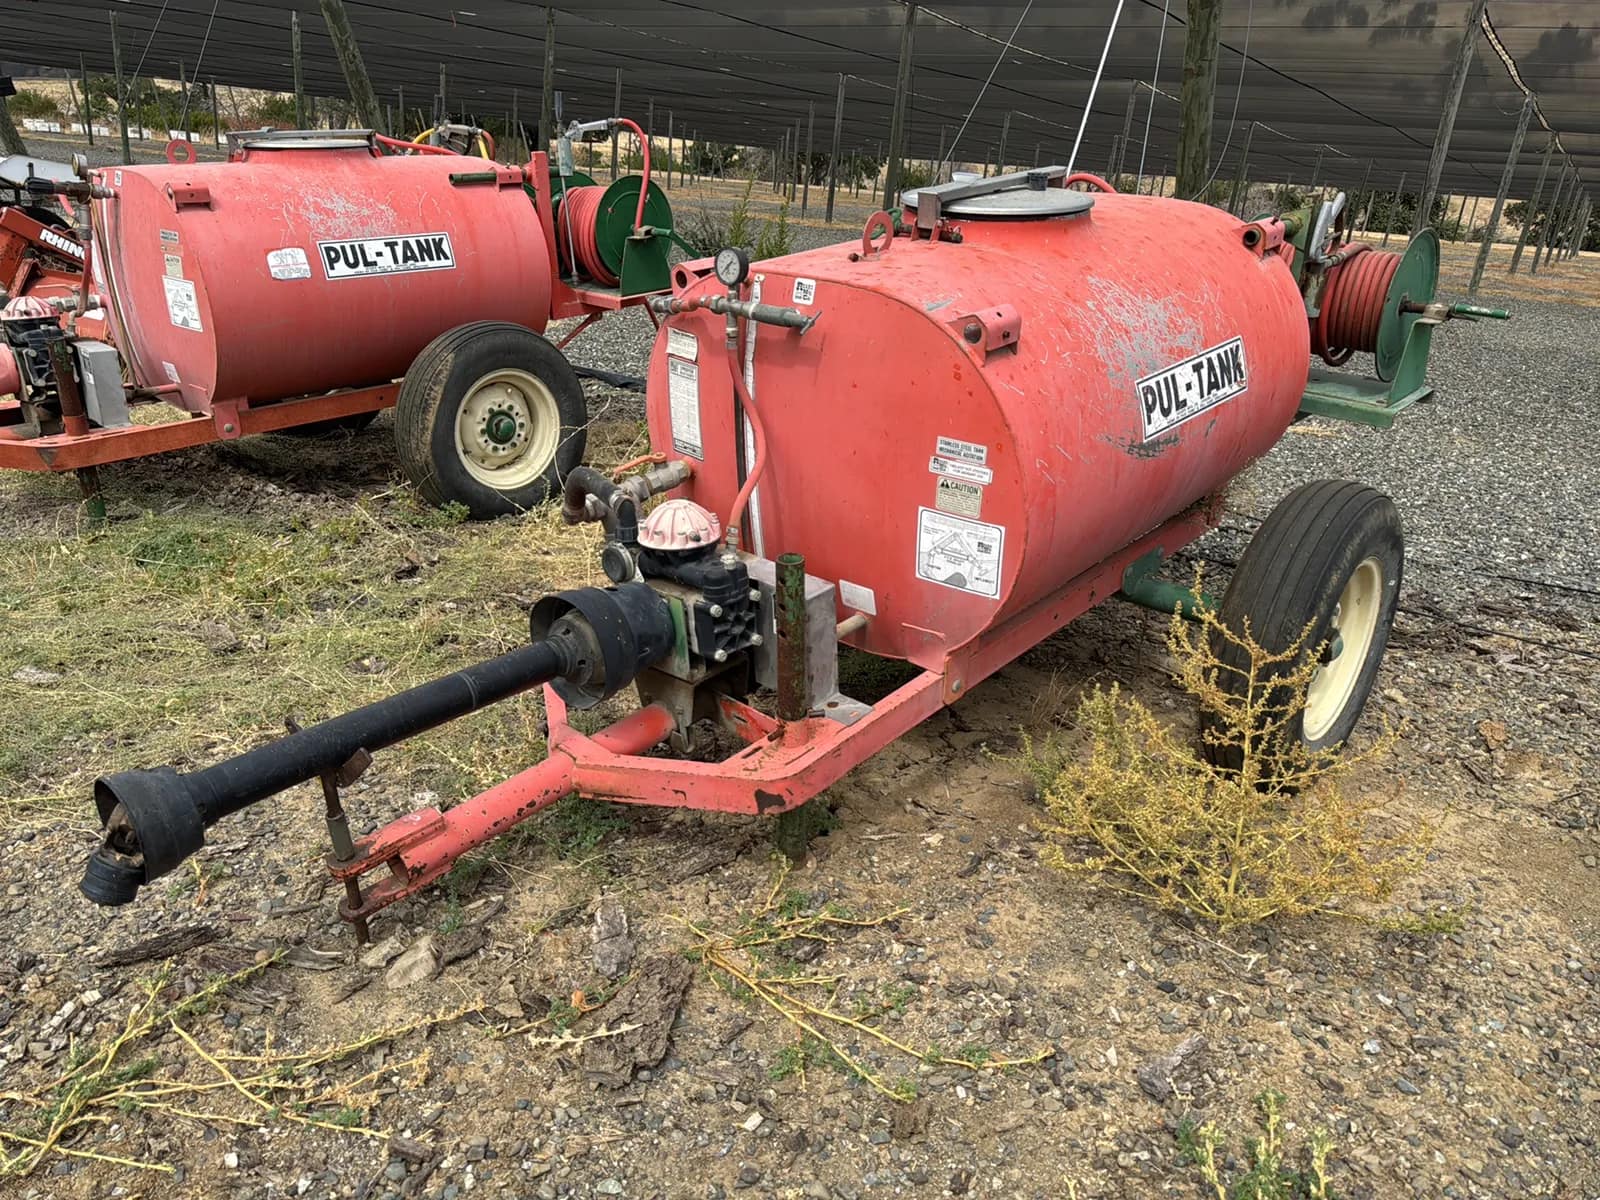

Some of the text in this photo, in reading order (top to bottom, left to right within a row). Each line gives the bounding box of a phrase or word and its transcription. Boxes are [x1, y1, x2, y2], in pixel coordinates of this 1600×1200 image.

[324, 237, 450, 270] PUL-TANK
[1141, 343, 1245, 426] PUL-TANK
[950, 481, 979, 495] CAUTION
